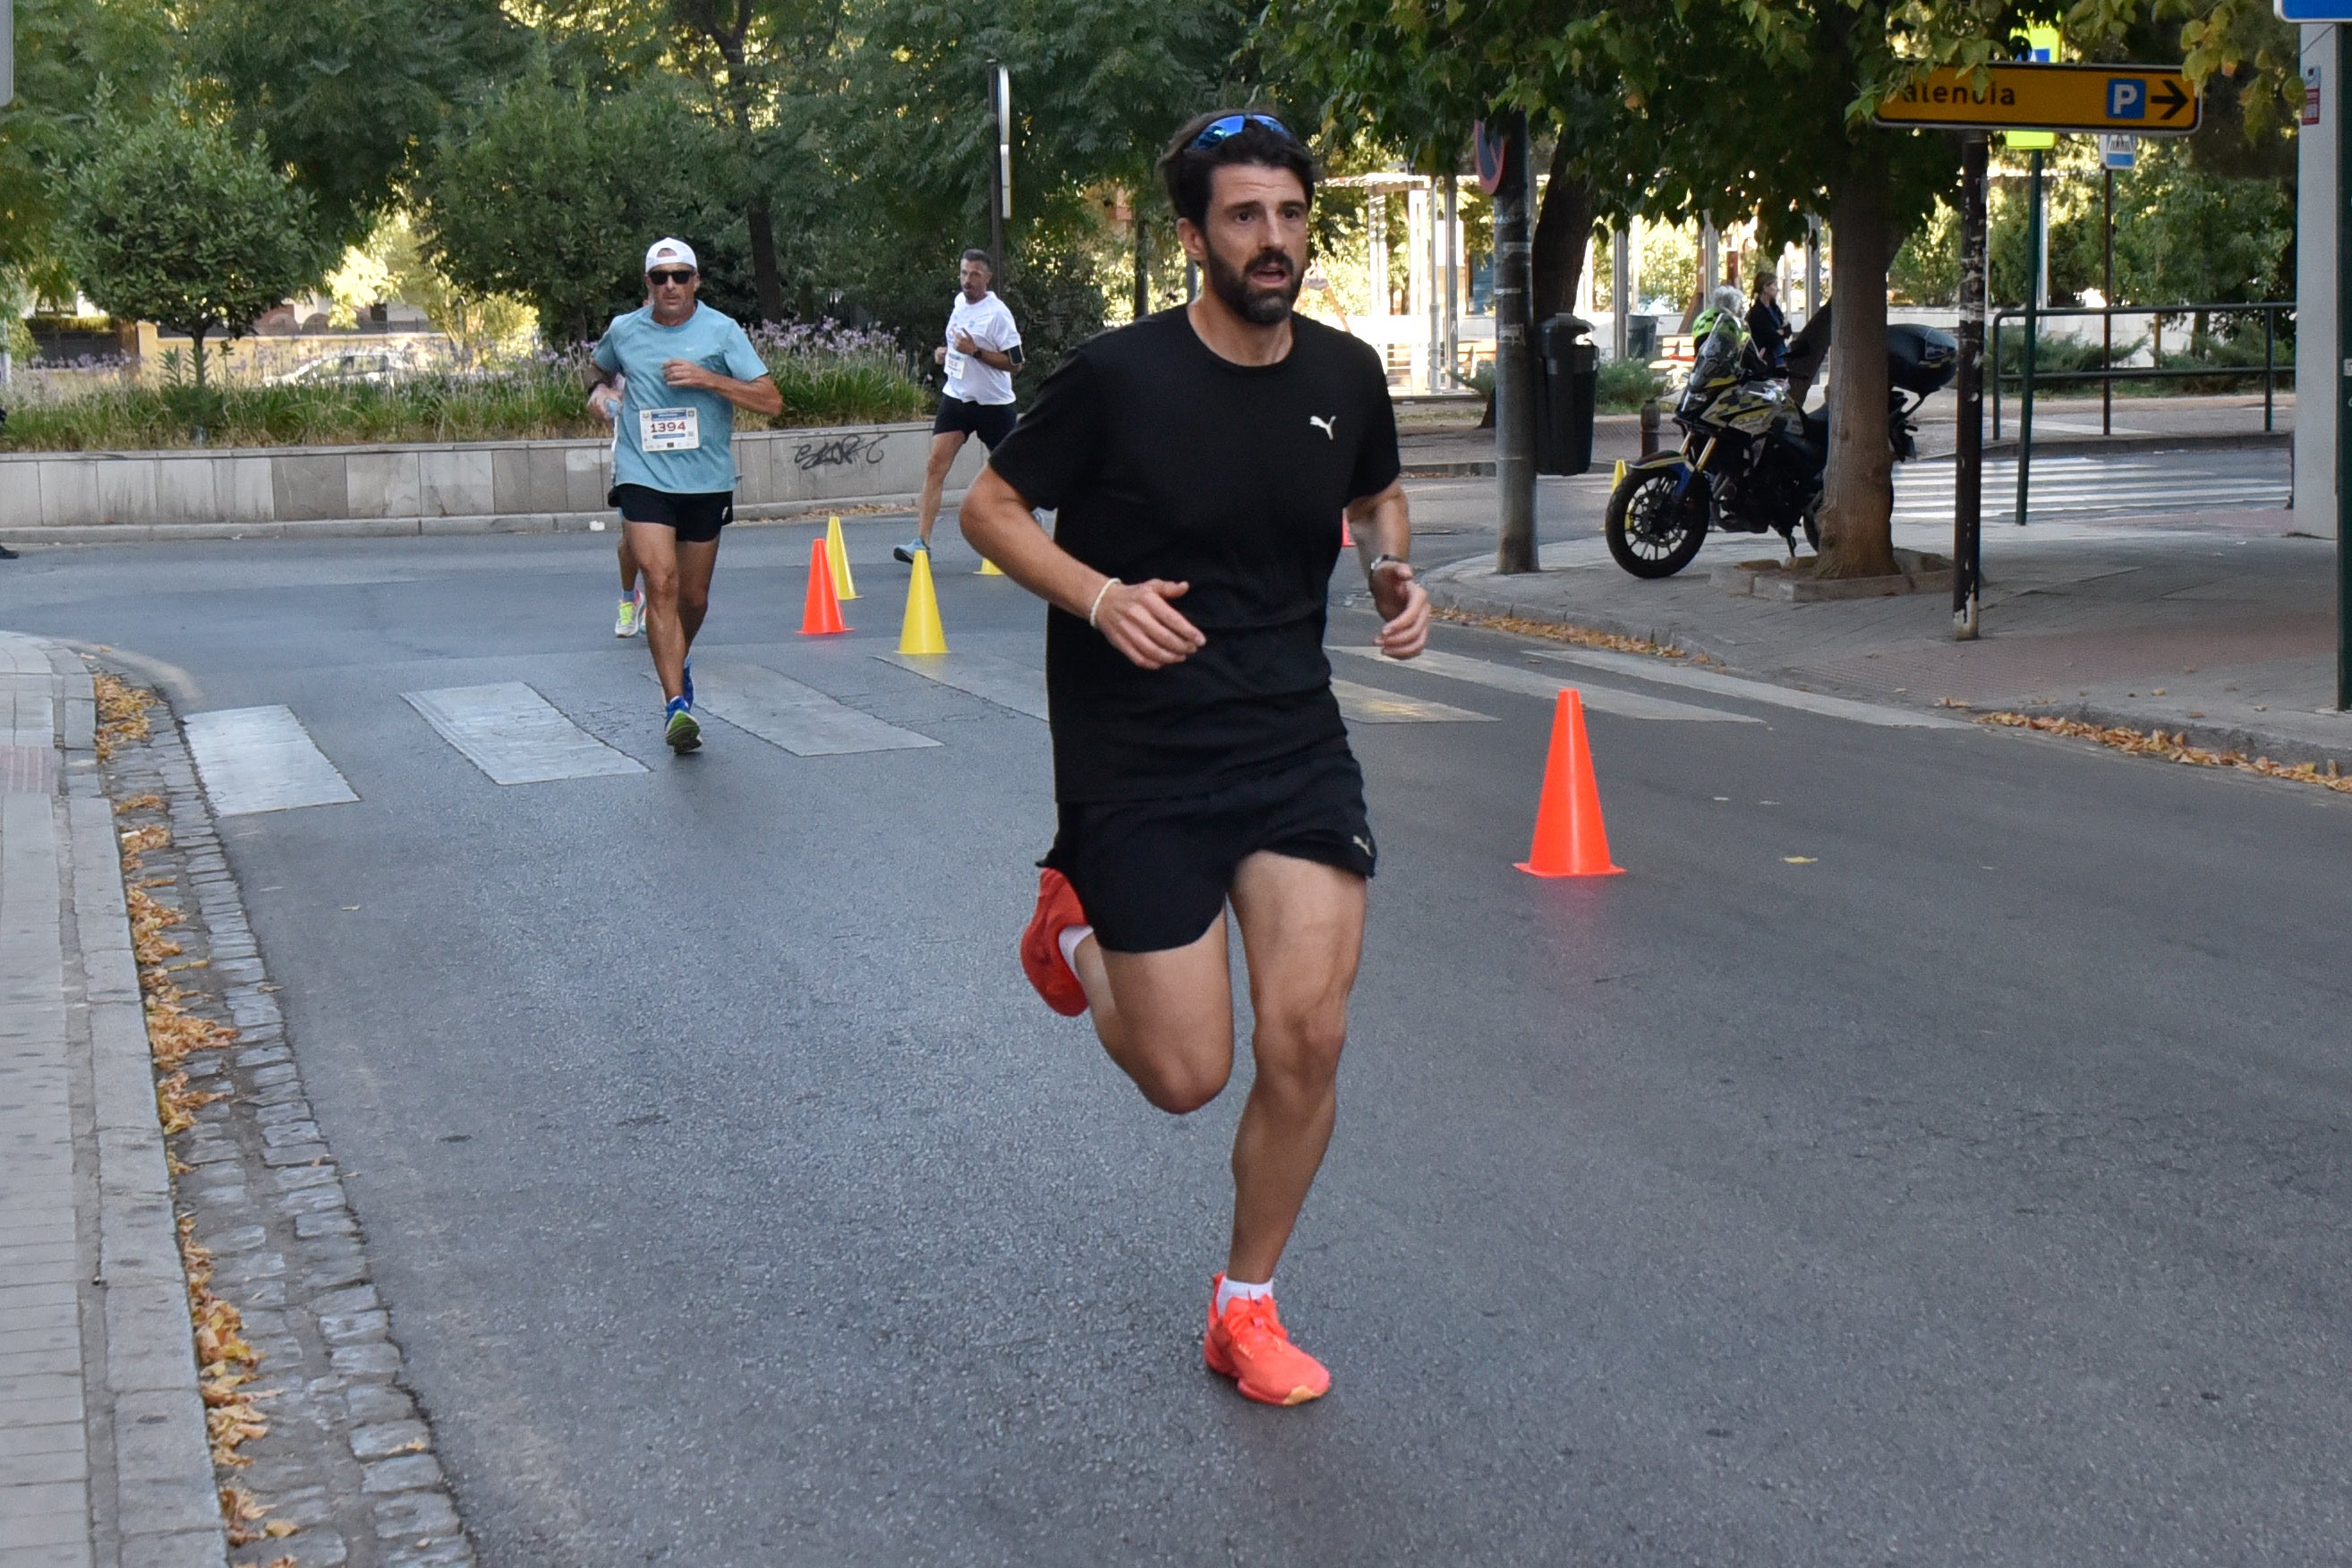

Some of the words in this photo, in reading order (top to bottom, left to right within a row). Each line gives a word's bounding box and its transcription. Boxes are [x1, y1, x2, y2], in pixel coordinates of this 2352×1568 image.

[1900, 81, 2016, 106] alencia
[2112, 83, 2138, 115] P
[651, 421, 686, 433] 1394
